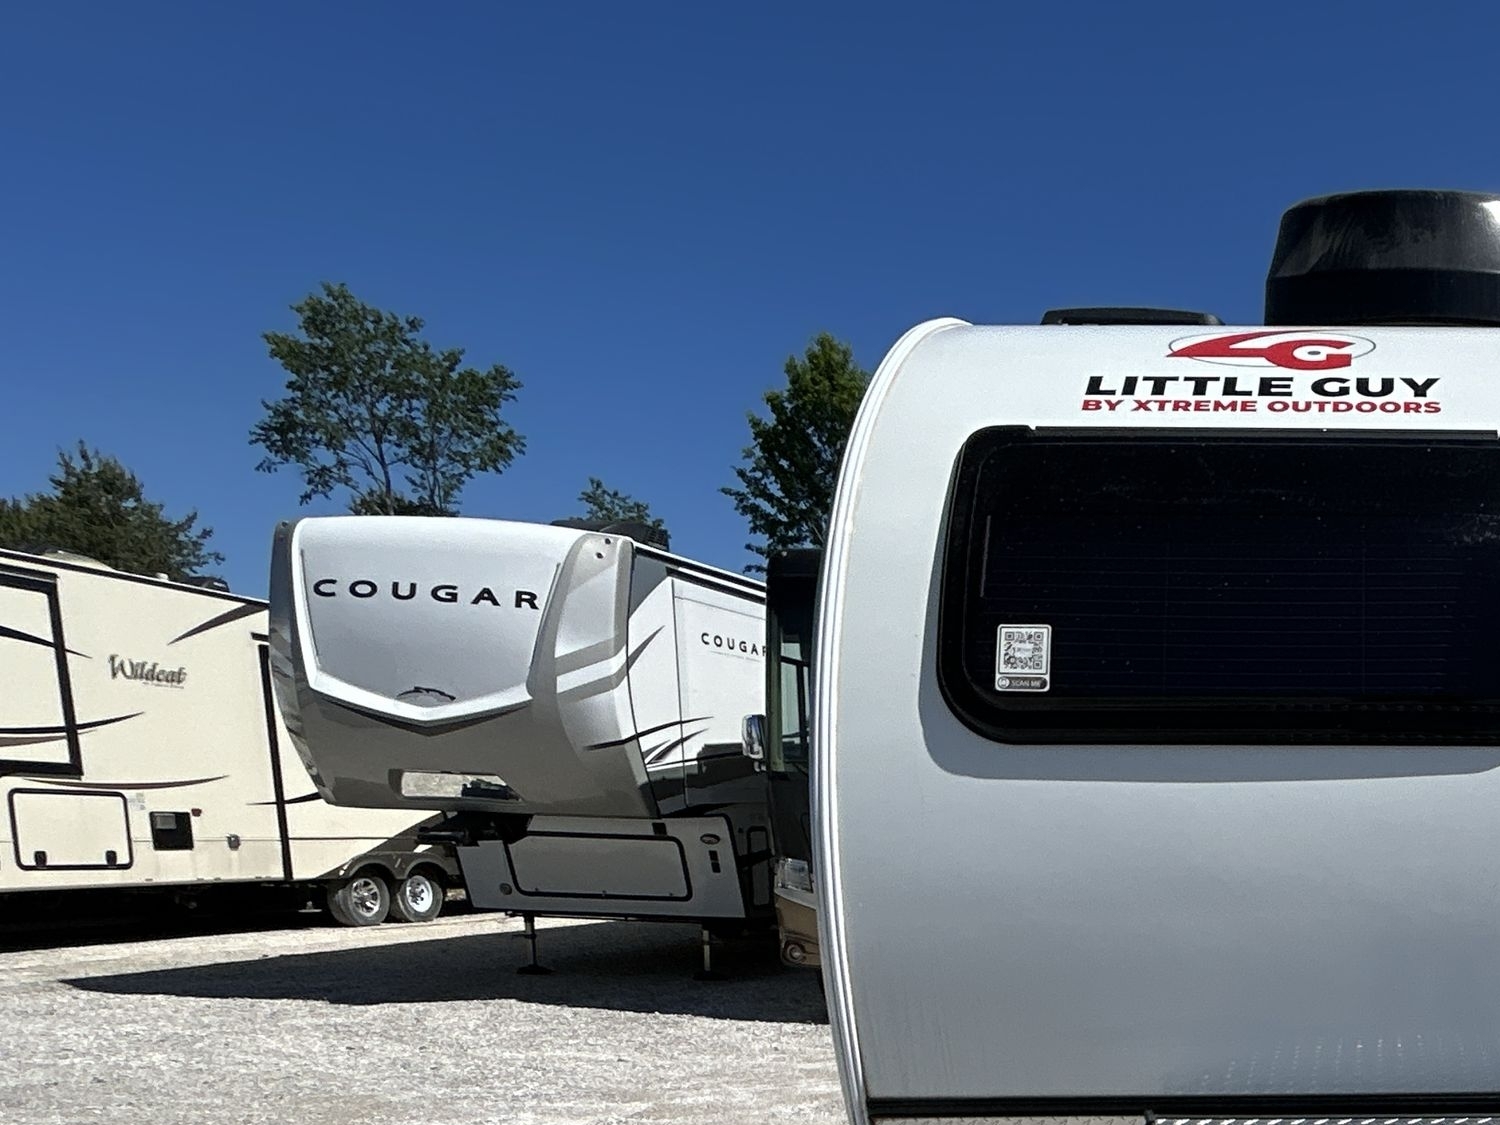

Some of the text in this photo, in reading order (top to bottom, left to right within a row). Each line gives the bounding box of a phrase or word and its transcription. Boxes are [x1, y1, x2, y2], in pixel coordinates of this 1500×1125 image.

[1084, 376, 1442, 398] LITTLE GUY
[1081, 399, 1442, 414] BY XTREME OUTDOORS
[312, 578, 540, 610] COUGAR
[108, 654, 187, 685] Wildcat
